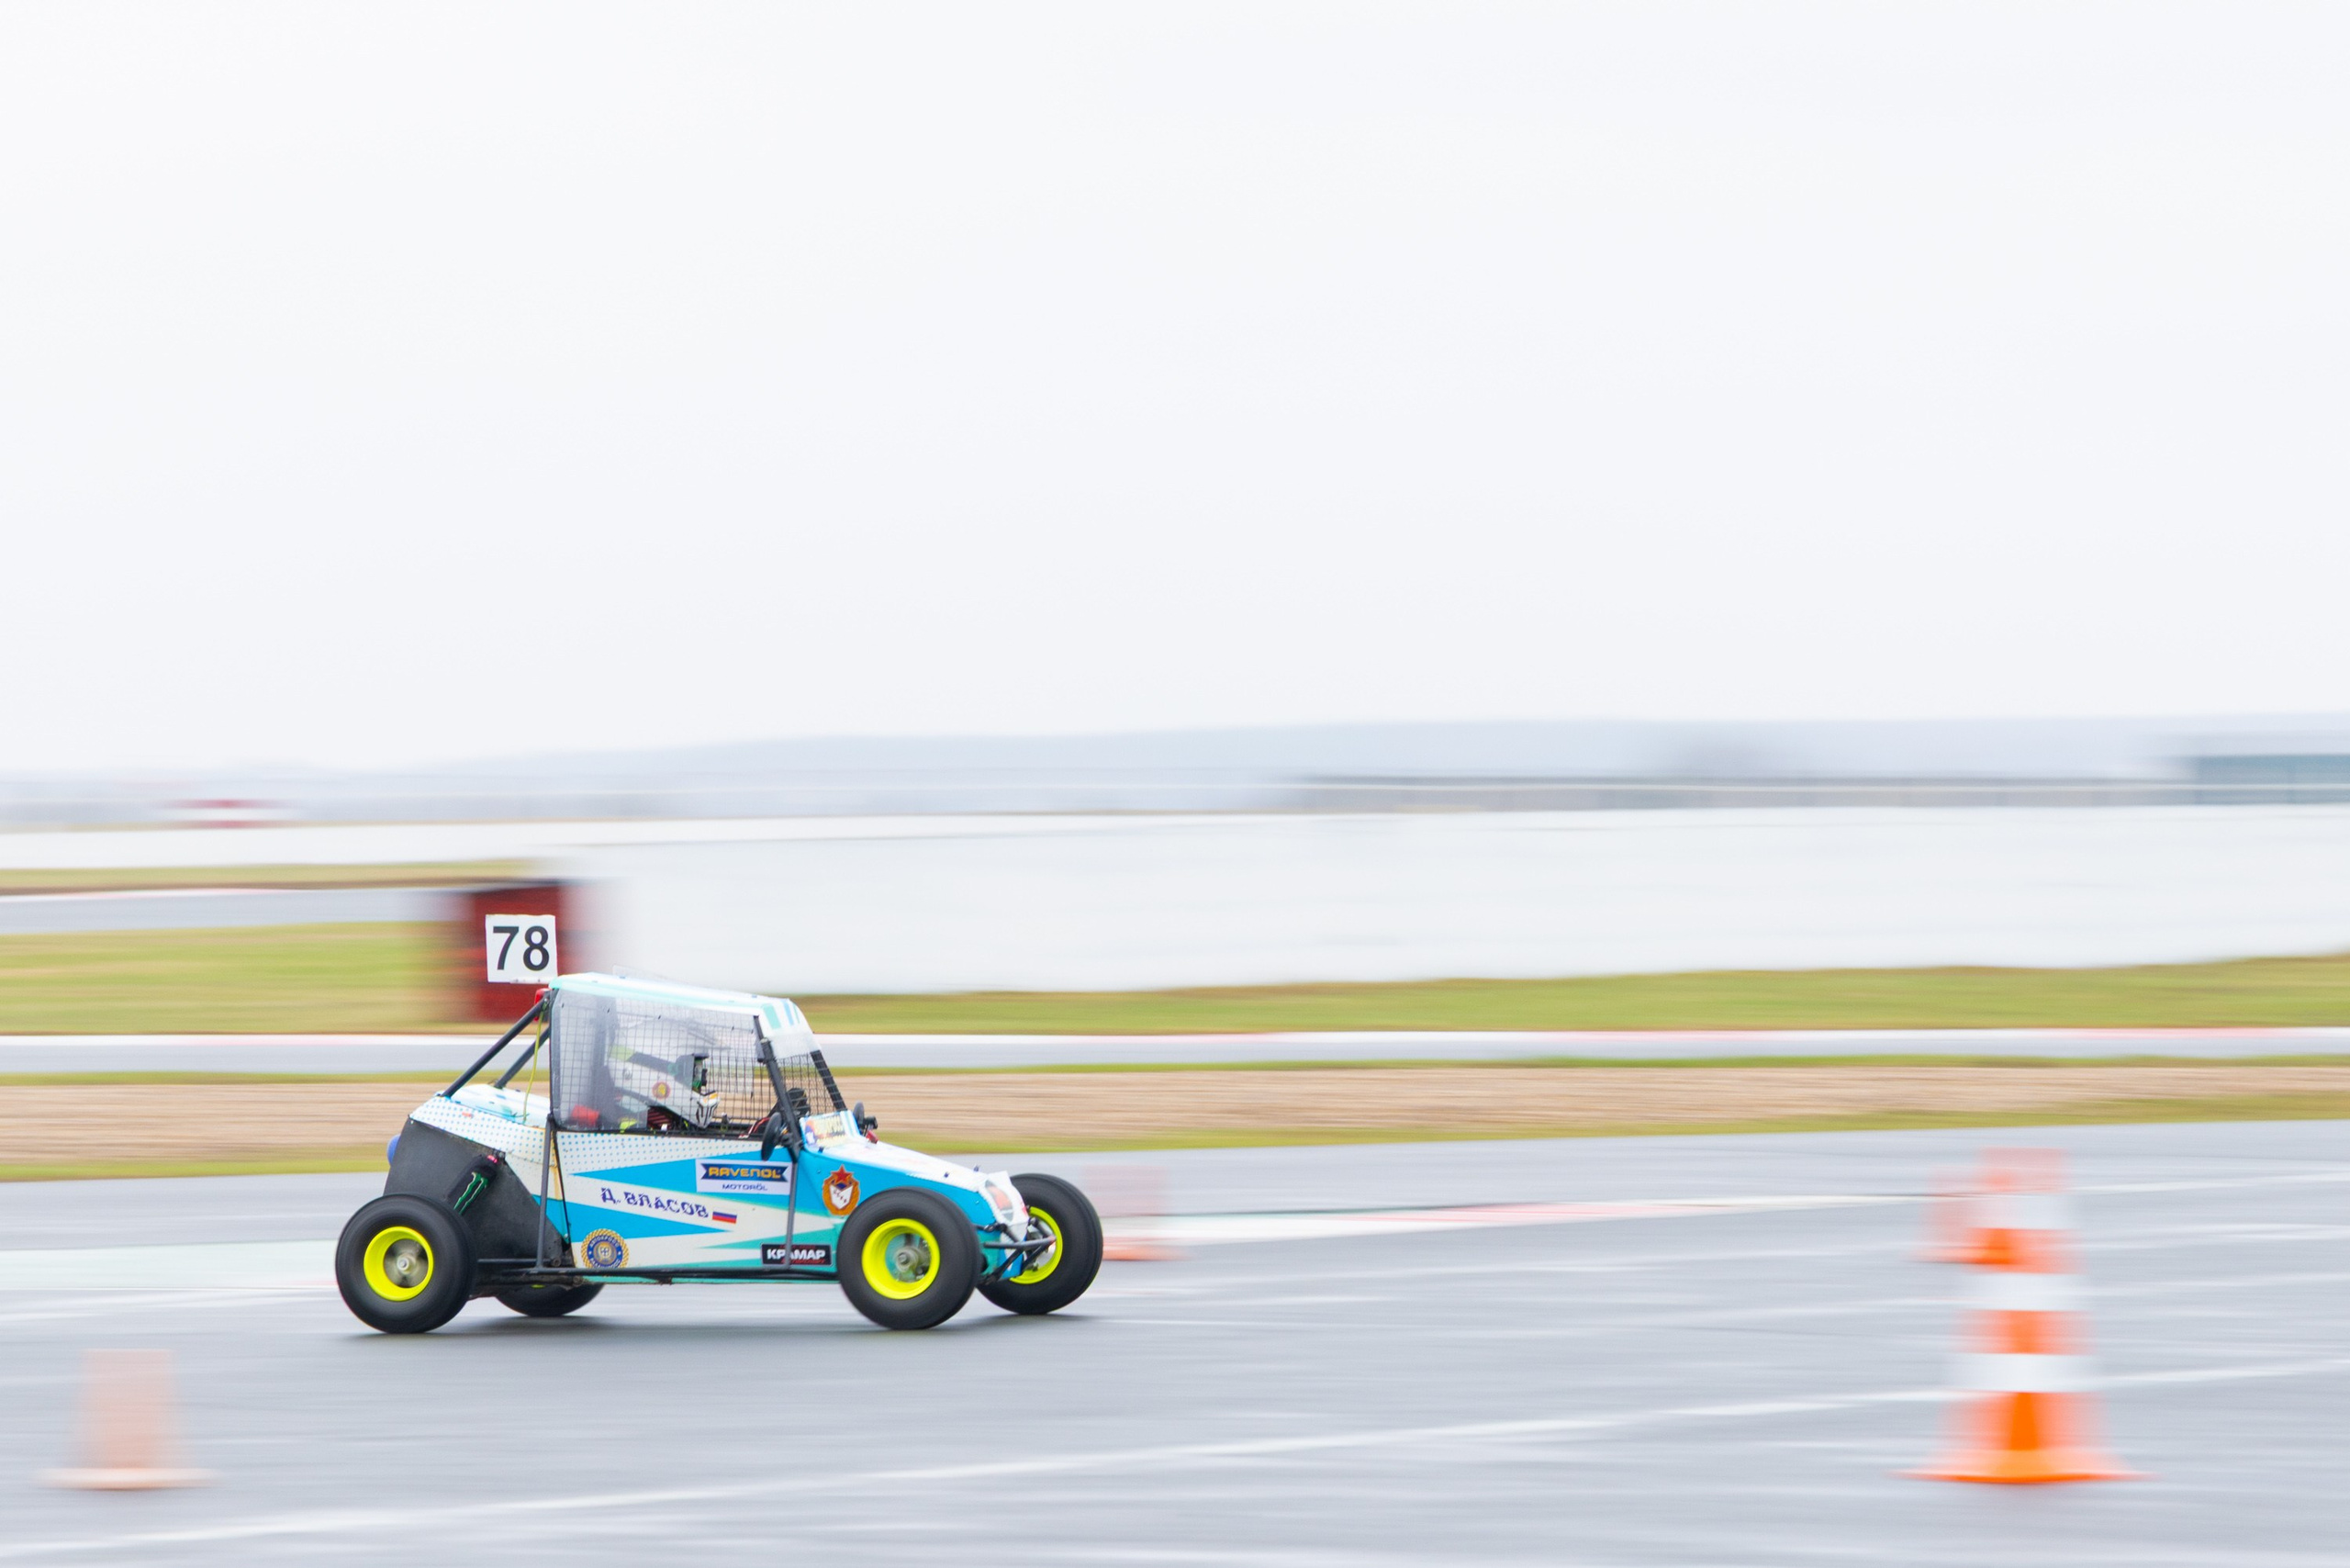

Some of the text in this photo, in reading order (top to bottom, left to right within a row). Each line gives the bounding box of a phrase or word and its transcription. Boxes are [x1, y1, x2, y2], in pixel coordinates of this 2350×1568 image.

[492, 925, 550, 971] 78
[708, 1167, 781, 1179] RAVENOL
[624, 1191, 709, 1217] ВЛАСОВ
